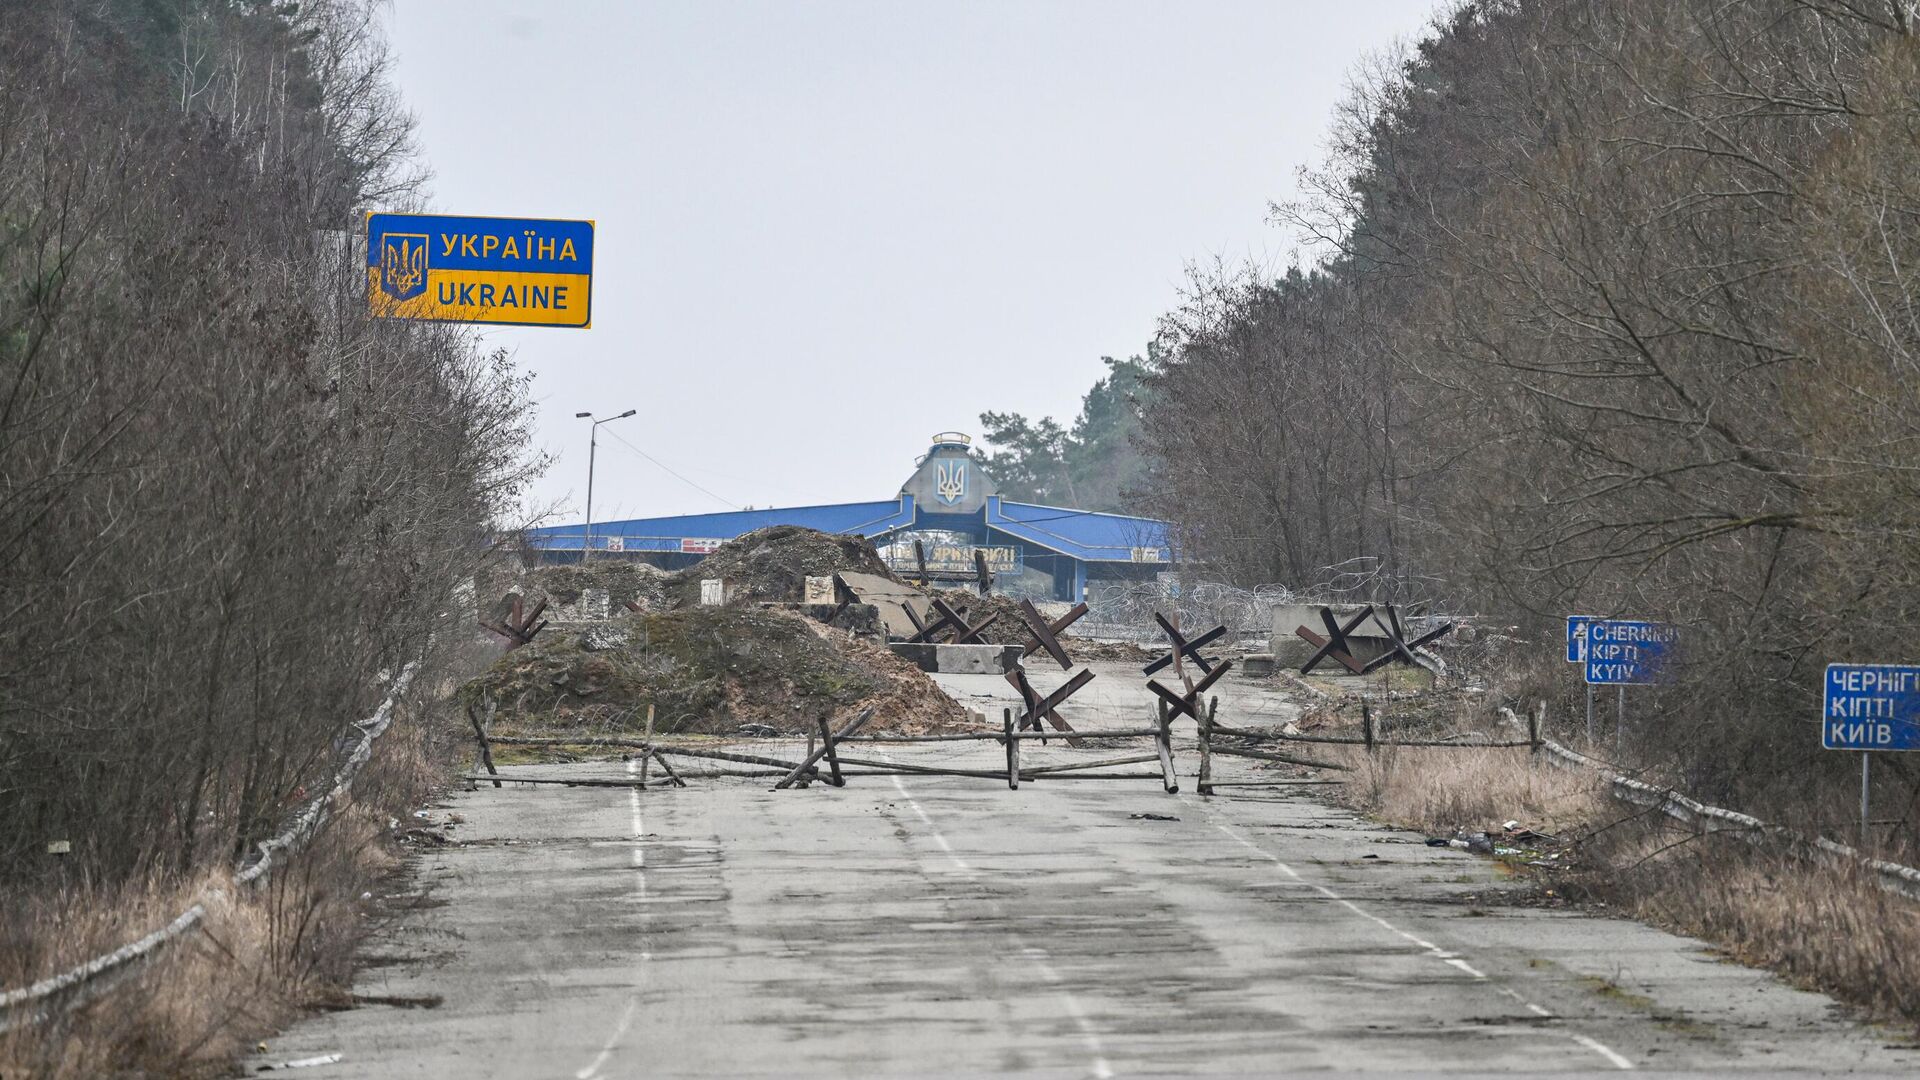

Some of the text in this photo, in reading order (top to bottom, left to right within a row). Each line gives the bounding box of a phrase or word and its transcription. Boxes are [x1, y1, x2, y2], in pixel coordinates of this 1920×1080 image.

[441, 230, 578, 262] УКРАЇНА
[438, 281, 568, 310] UKRAINE
[1592, 644, 1638, 660] KIPTI
[1591, 663, 1635, 680] KYIV
[1831, 696, 1894, 718] КІПТІ
[1831, 719, 1892, 744] КИЇВ
